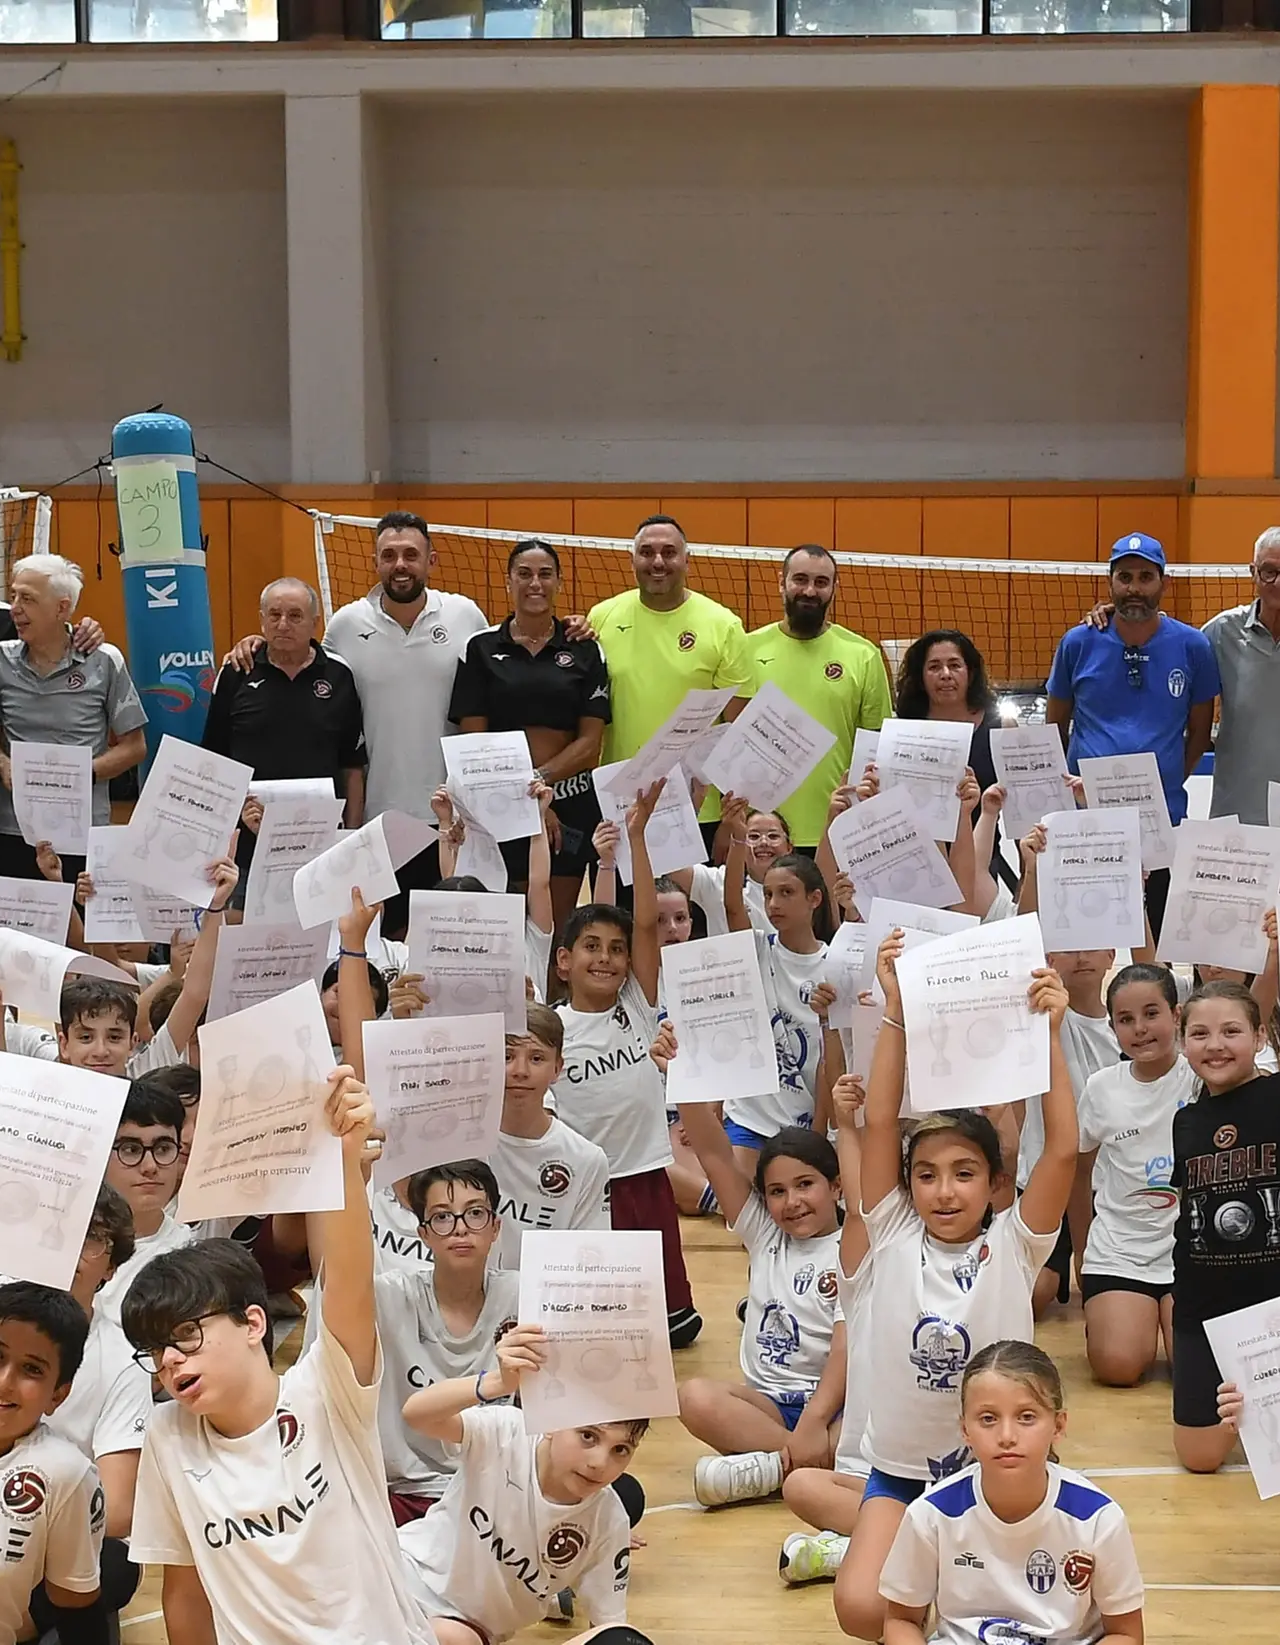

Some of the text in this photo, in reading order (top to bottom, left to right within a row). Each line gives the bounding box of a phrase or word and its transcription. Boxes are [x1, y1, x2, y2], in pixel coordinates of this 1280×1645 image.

[119, 480, 178, 505] CAMPO
[138, 504, 162, 549] 3
[389, 1047, 422, 1057] Attestato
[431, 1042, 486, 1056] partecipazione
[35, 1093, 98, 1117] partecipazione
[1186, 1142, 1277, 1190] TREBLE
[543, 1263, 576, 1273] Attestato
[584, 1263, 642, 1275] partecipazione
[1236, 1334, 1268, 1349] Attestato
[203, 1462, 330, 1550] CANALE
